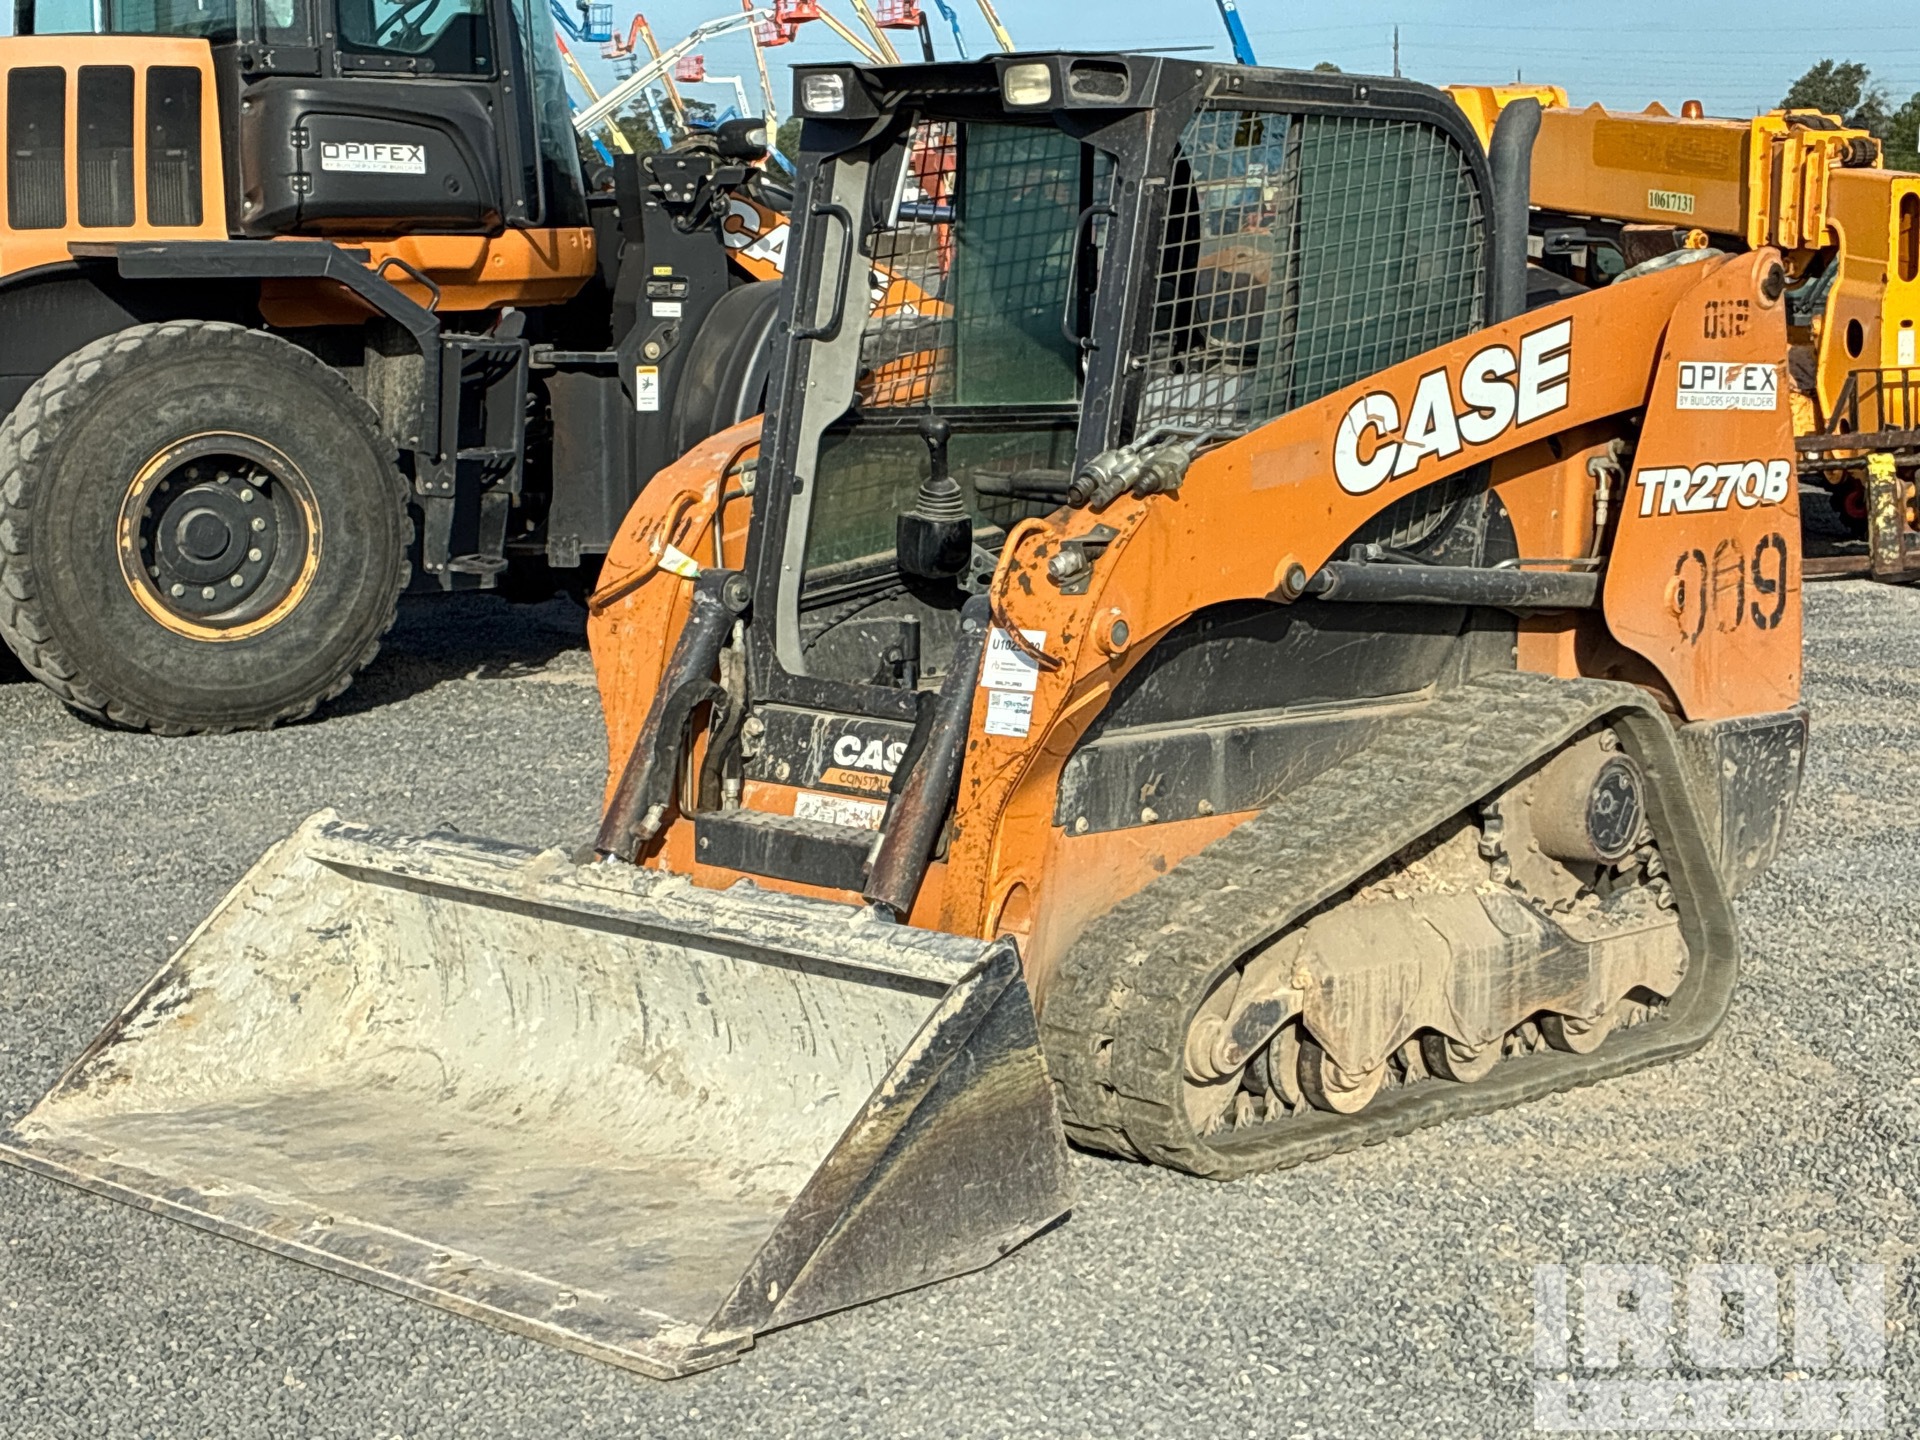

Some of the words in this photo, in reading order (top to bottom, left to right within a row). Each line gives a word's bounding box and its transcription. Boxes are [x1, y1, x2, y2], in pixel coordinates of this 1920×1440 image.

[323, 144, 422, 162] OPIFEX
[1650, 192, 1693, 213] 10617131
[1333, 316, 1573, 496] CASE
[1680, 396, 1688, 405] BY
[1690, 396, 1723, 406] BUILDERS
[1726, 396, 1740, 405] FOR
[1741, 396, 1774, 407] BUILDERS
[1637, 458, 1791, 518] TR270B
[833, 735, 908, 773] CAS
